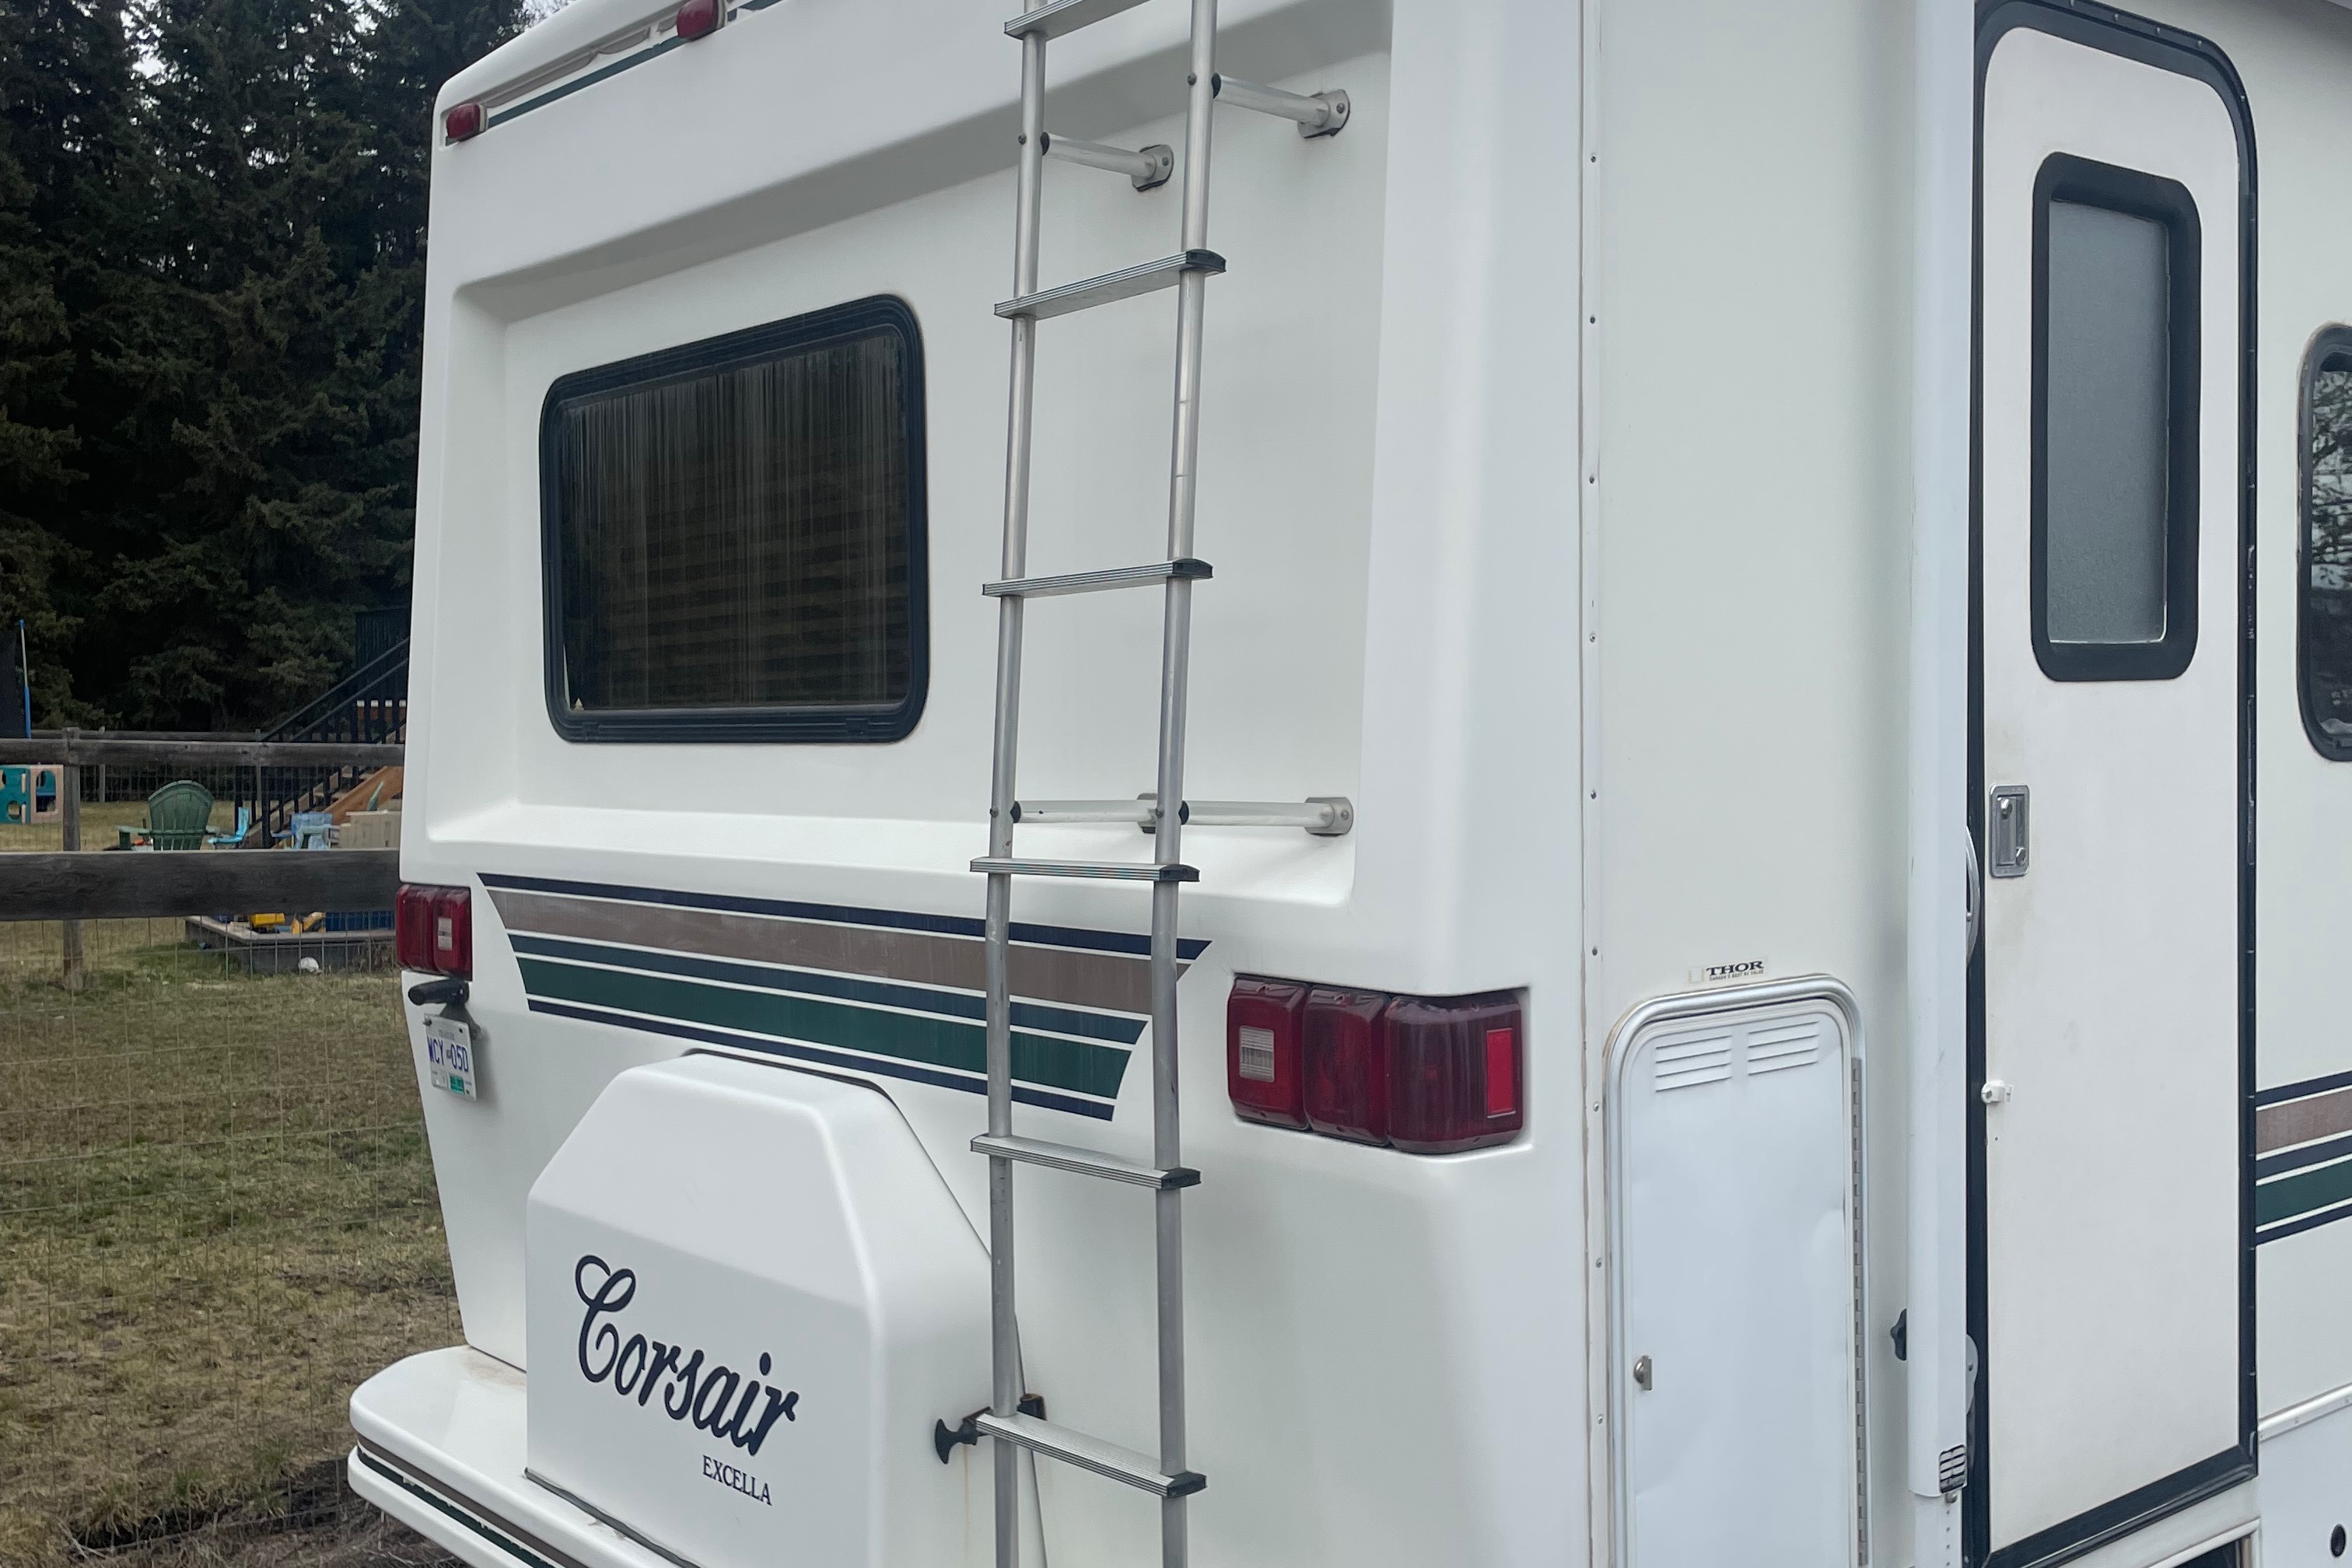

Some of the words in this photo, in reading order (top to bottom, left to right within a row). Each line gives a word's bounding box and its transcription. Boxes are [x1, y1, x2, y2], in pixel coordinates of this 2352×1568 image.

[1706, 961, 1764, 976] THOR
[575, 1255, 800, 1456] Corsair
[702, 1454, 772, 1506] EXCELLA
